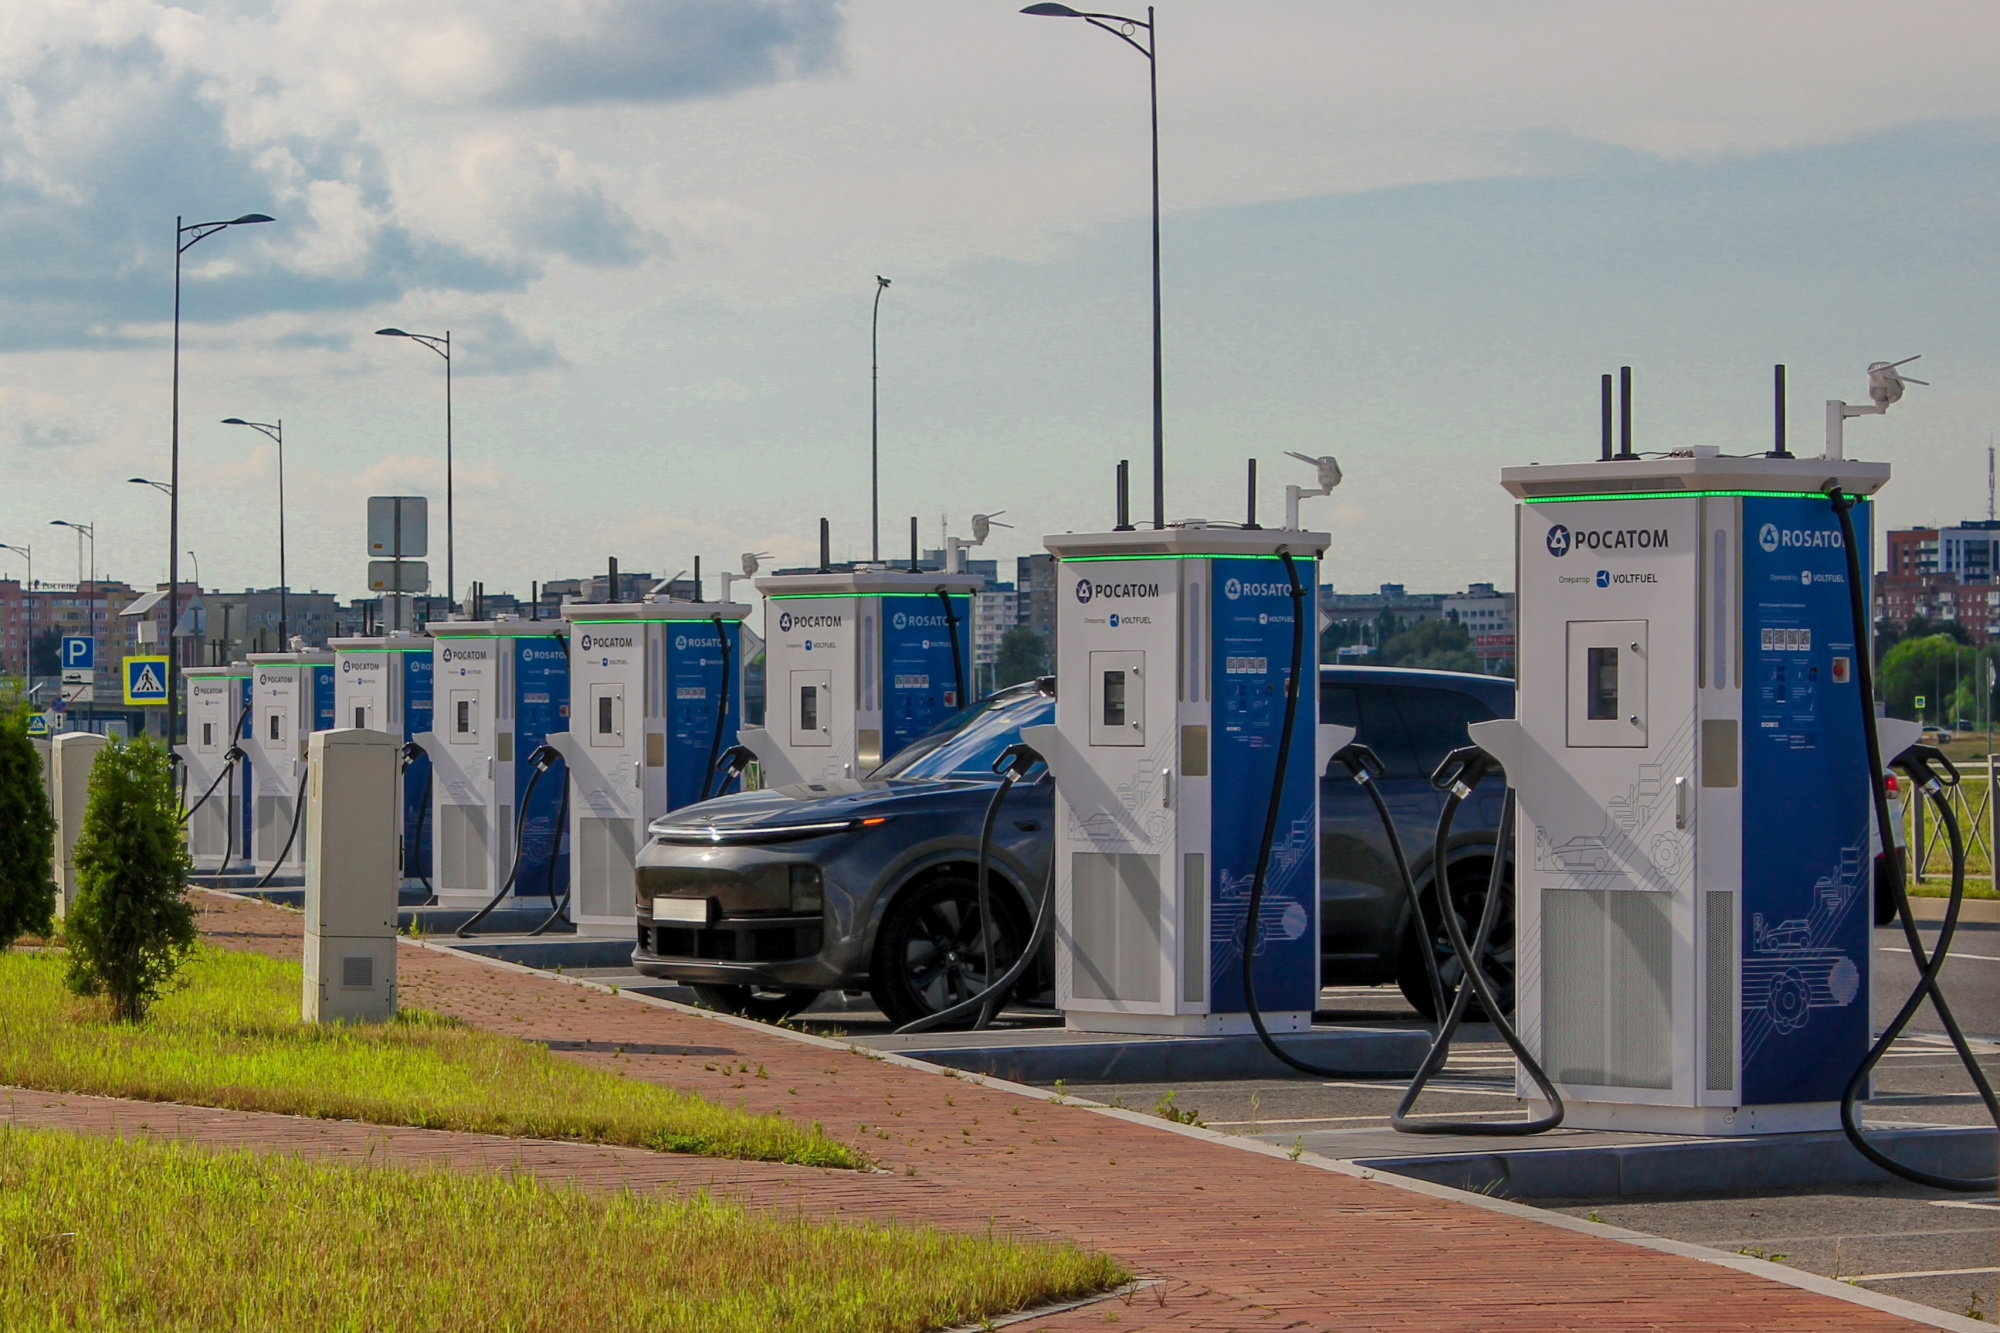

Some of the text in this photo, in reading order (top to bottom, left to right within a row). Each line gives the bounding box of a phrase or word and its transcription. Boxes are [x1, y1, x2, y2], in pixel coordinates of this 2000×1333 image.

[1575, 529, 1669, 549] РОСАТОМ
[1782, 530, 1845, 548] ROSATO
[1559, 574, 1658, 584] Оператор VOLTFUEL
[1813, 574, 1845, 583] VOLTFUEL
[1095, 583, 1159, 598] РОСАТОМ
[1243, 583, 1303, 596] ROSATO
[794, 616, 842, 628] РОСАТОМ
[908, 615, 960, 627] ROSATO
[1121, 616, 1151, 624] VOLTFUEL
[593, 637, 633, 648] РОСАТОМ
[453, 651, 487, 660] РОСАТОМ
[534, 651, 567, 659] ROSATO
[351, 663, 380, 671] РОСАТОМ
